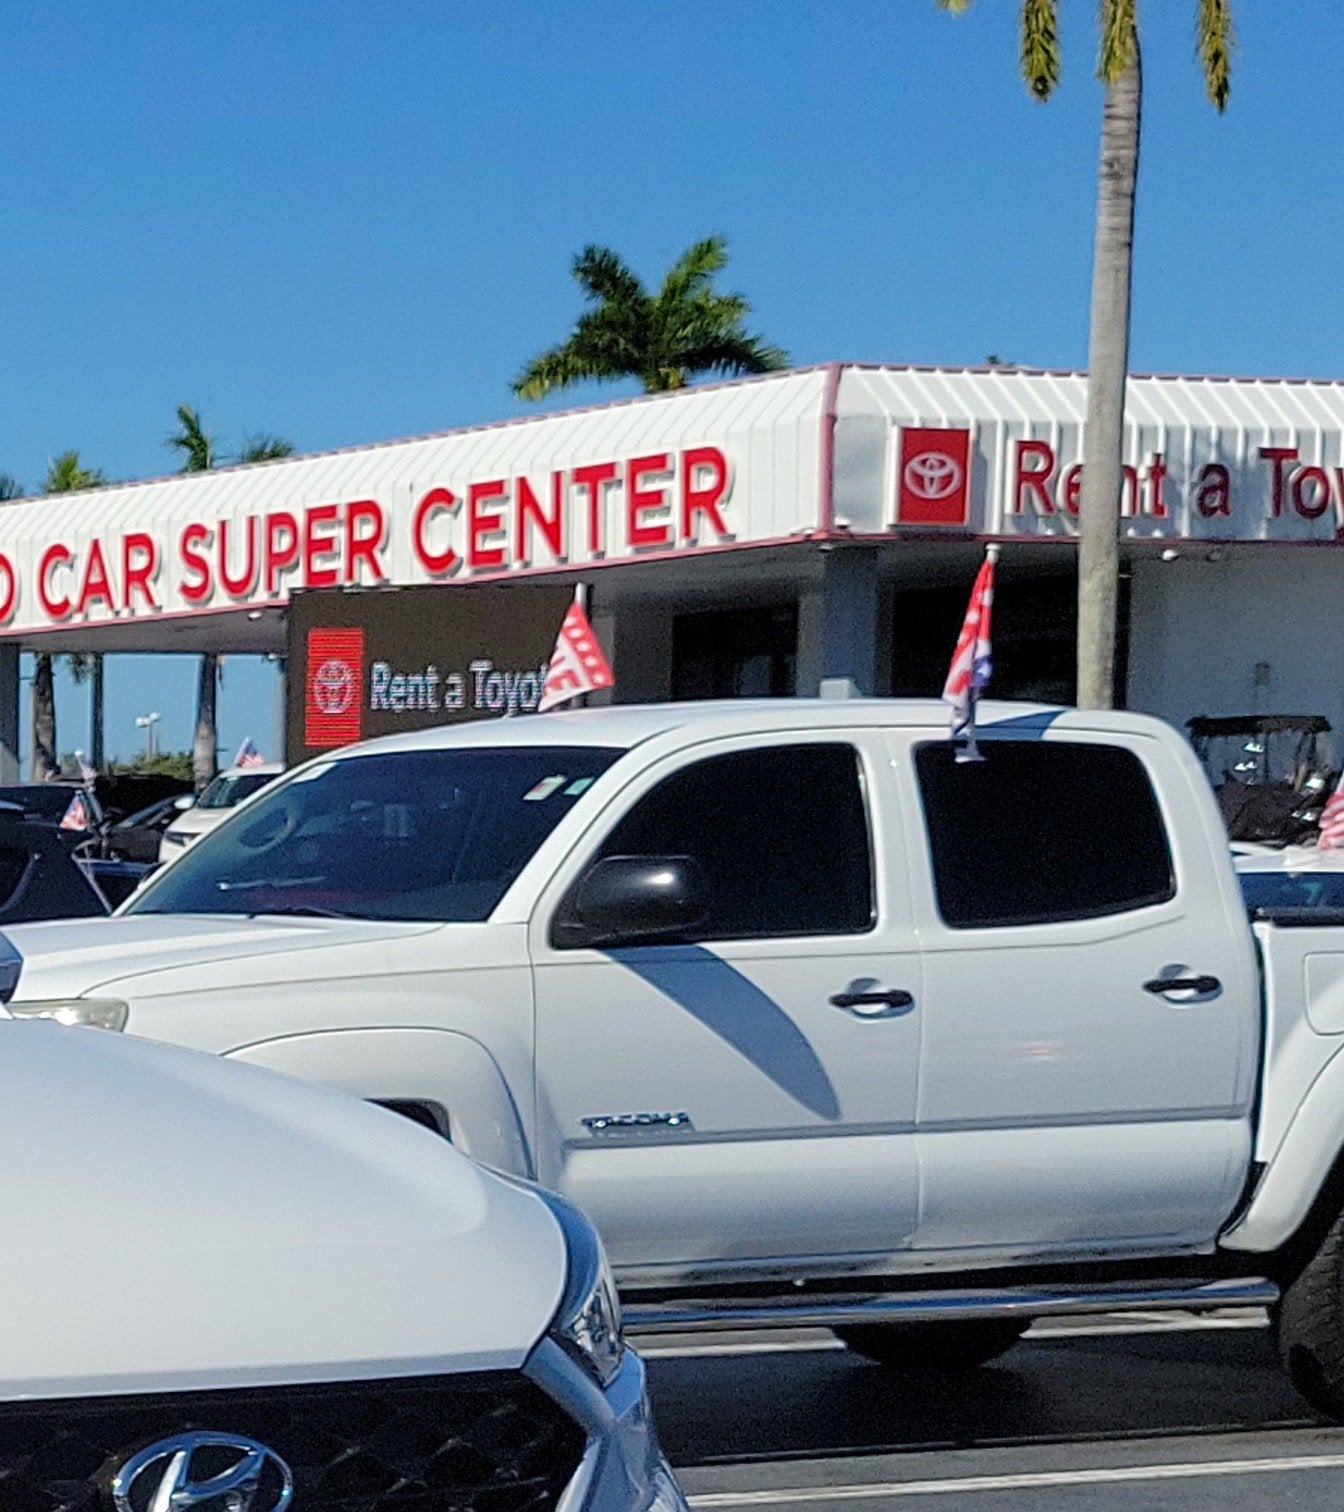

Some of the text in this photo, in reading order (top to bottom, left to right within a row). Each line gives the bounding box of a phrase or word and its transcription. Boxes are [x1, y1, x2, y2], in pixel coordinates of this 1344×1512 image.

[1196, 463, 1231, 518] a
[36, 532, 158, 617] CAR
[180, 500, 385, 600] SUPER
[413, 446, 730, 574] CENTER
[371, 660, 439, 711] Rent
[444, 673, 463, 711] a
[468, 658, 550, 716] Toyo
